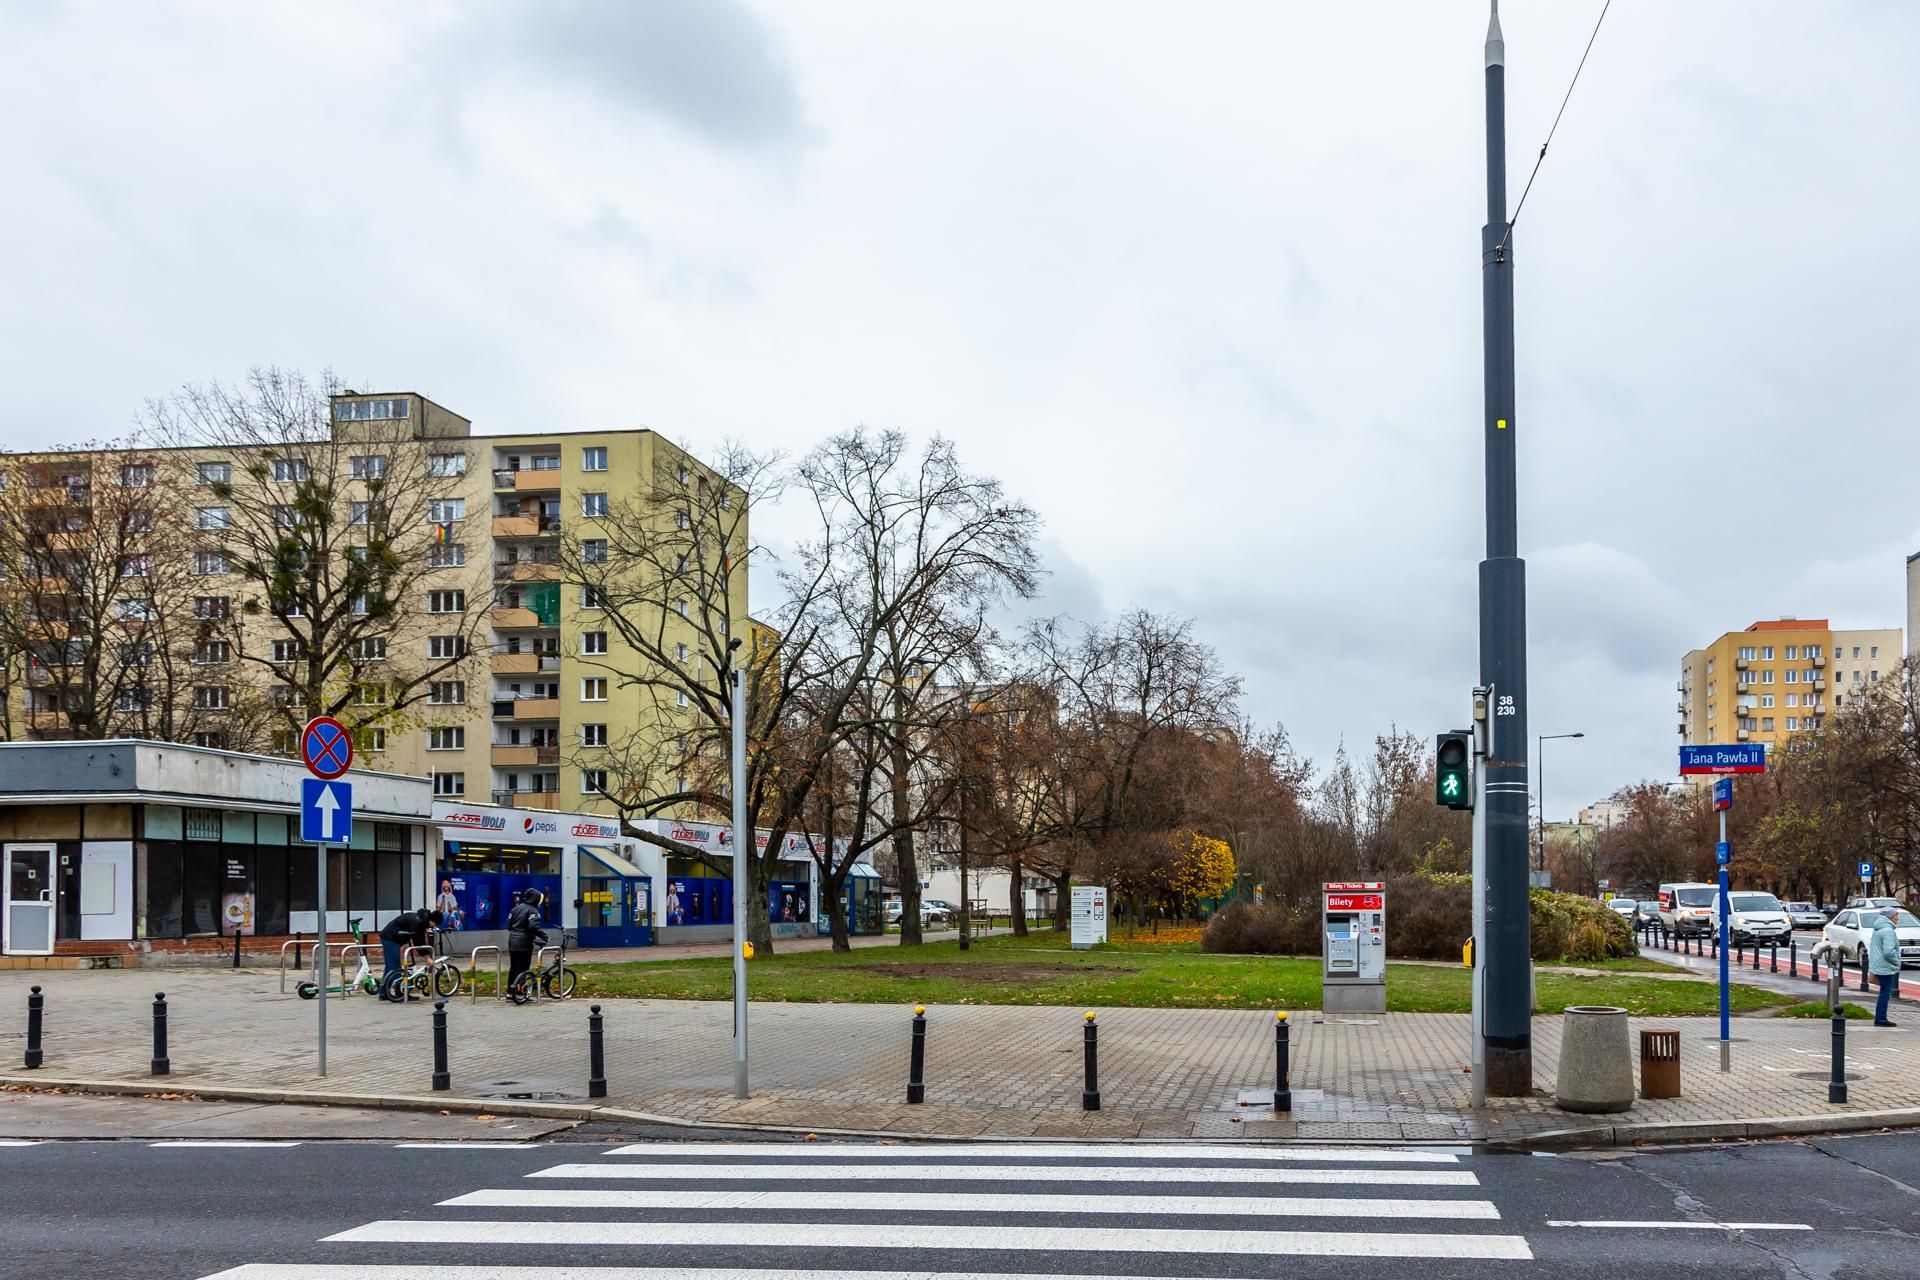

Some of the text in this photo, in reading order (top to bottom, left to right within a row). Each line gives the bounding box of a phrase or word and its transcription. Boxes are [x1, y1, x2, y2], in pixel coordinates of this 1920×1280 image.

[1499, 696, 1514, 706] 38
[1497, 706, 1516, 716] 230
[1689, 752, 1758, 764] Jana Pawła II
[481, 816, 506, 828] WOLA
[535, 822, 556, 834] pepsi
[599, 826, 618, 838] WOLA
[1862, 864, 1870, 874] P
[1330, 898, 1353, 907] Bilety
